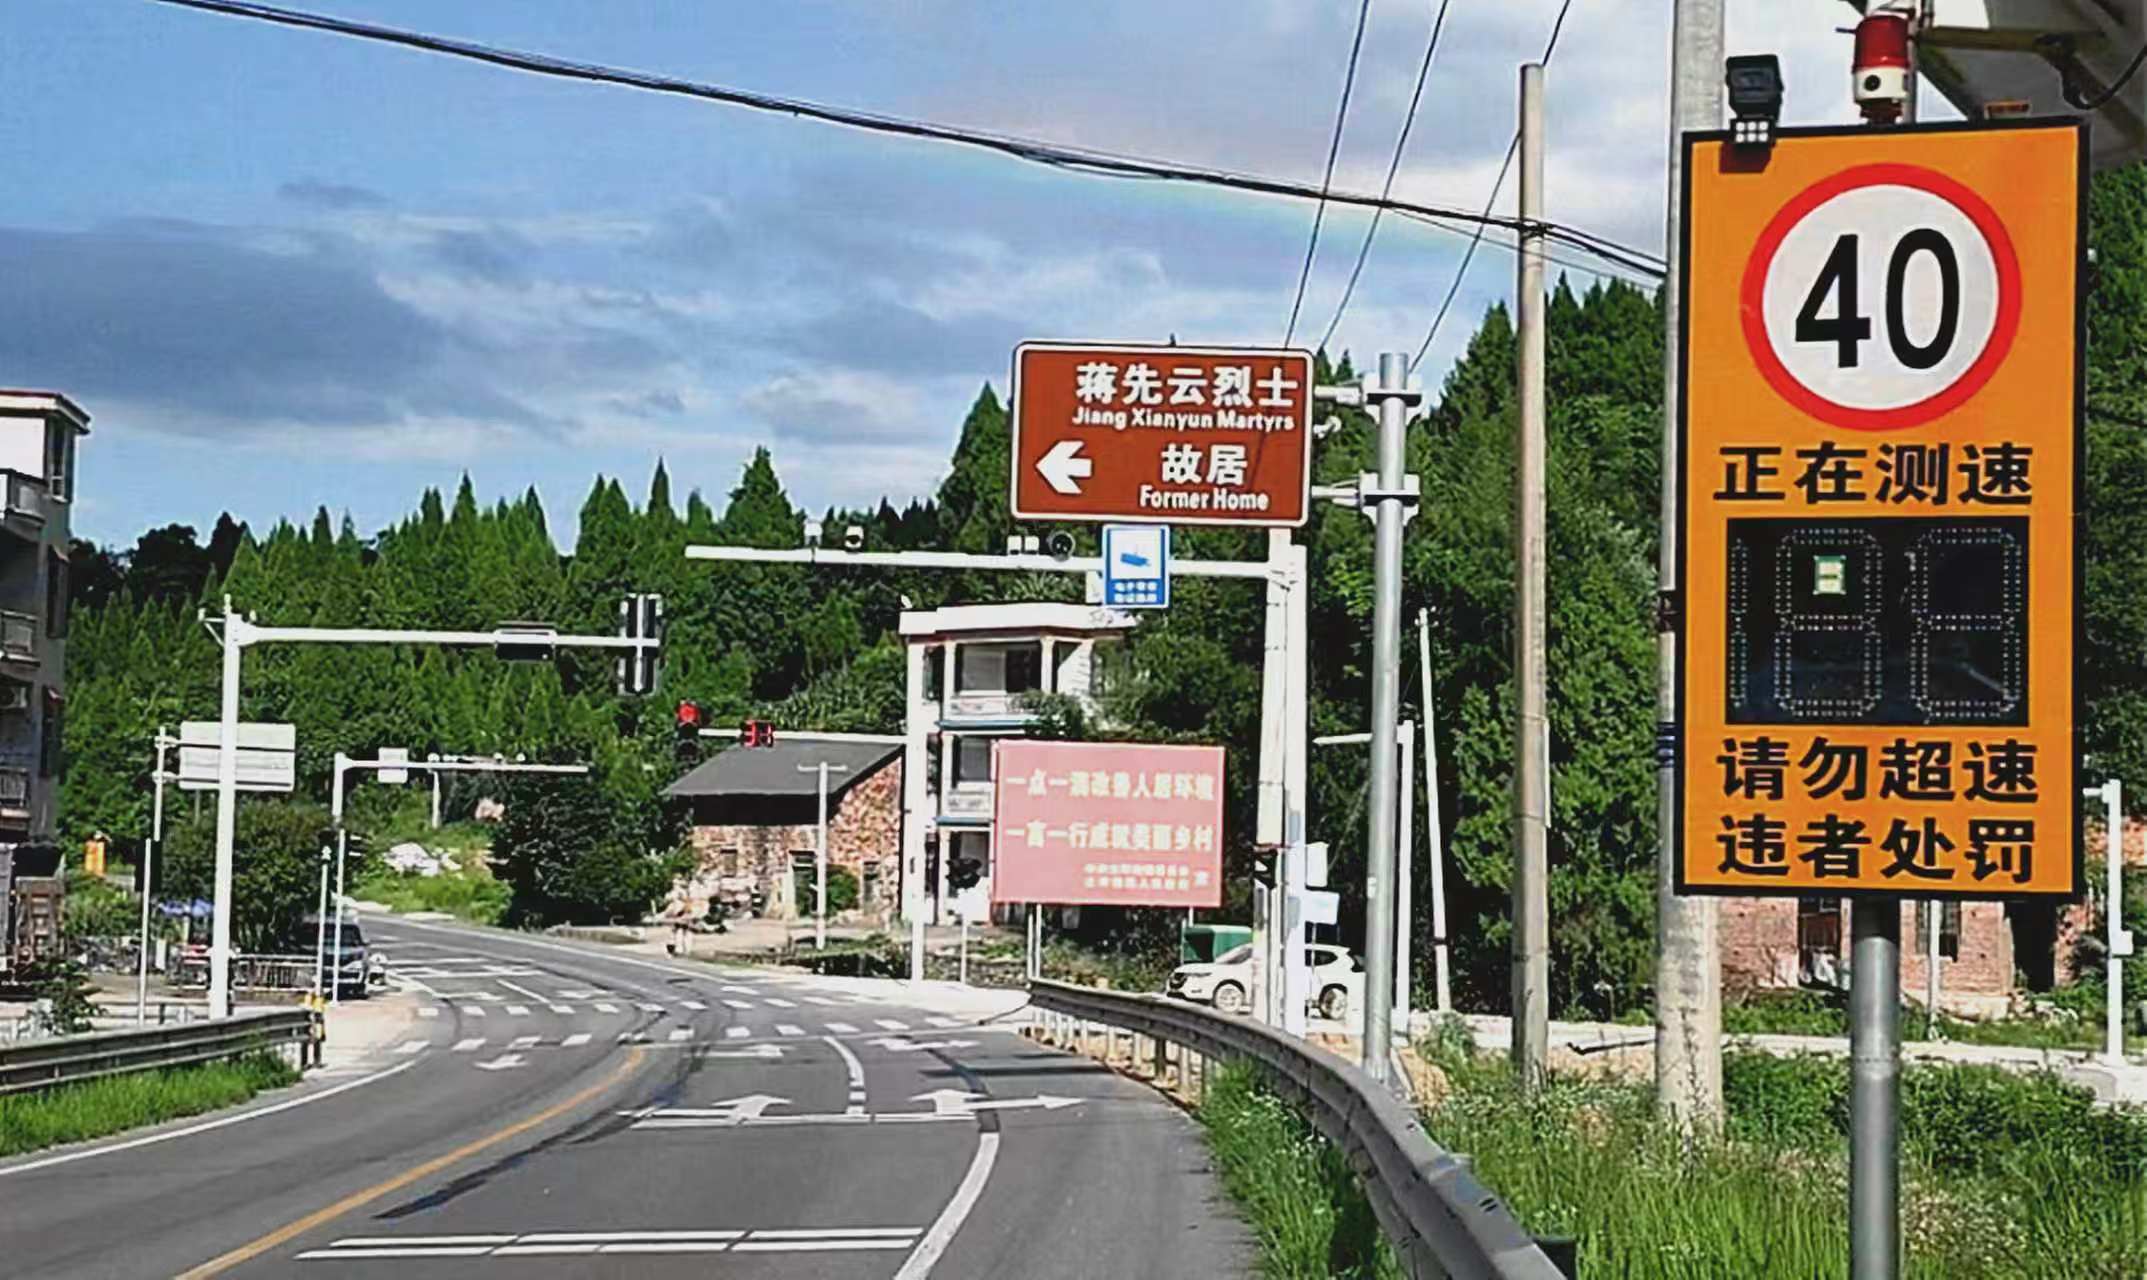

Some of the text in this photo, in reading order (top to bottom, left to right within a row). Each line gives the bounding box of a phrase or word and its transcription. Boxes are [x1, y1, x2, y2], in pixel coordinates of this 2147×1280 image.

[1795, 228, 1959, 369] 40
[1075, 361, 1298, 408] 蒋先云烈士
[1072, 406, 1294, 433] Jiang Xianyun Martyrs
[1160, 442, 1248, 486] 故居
[1713, 441, 2033, 506] 正在测速
[1139, 485, 1269, 511] Former Home
[1716, 736, 2039, 804] 请勿超速
[1716, 813, 2036, 884] 违者处罚
